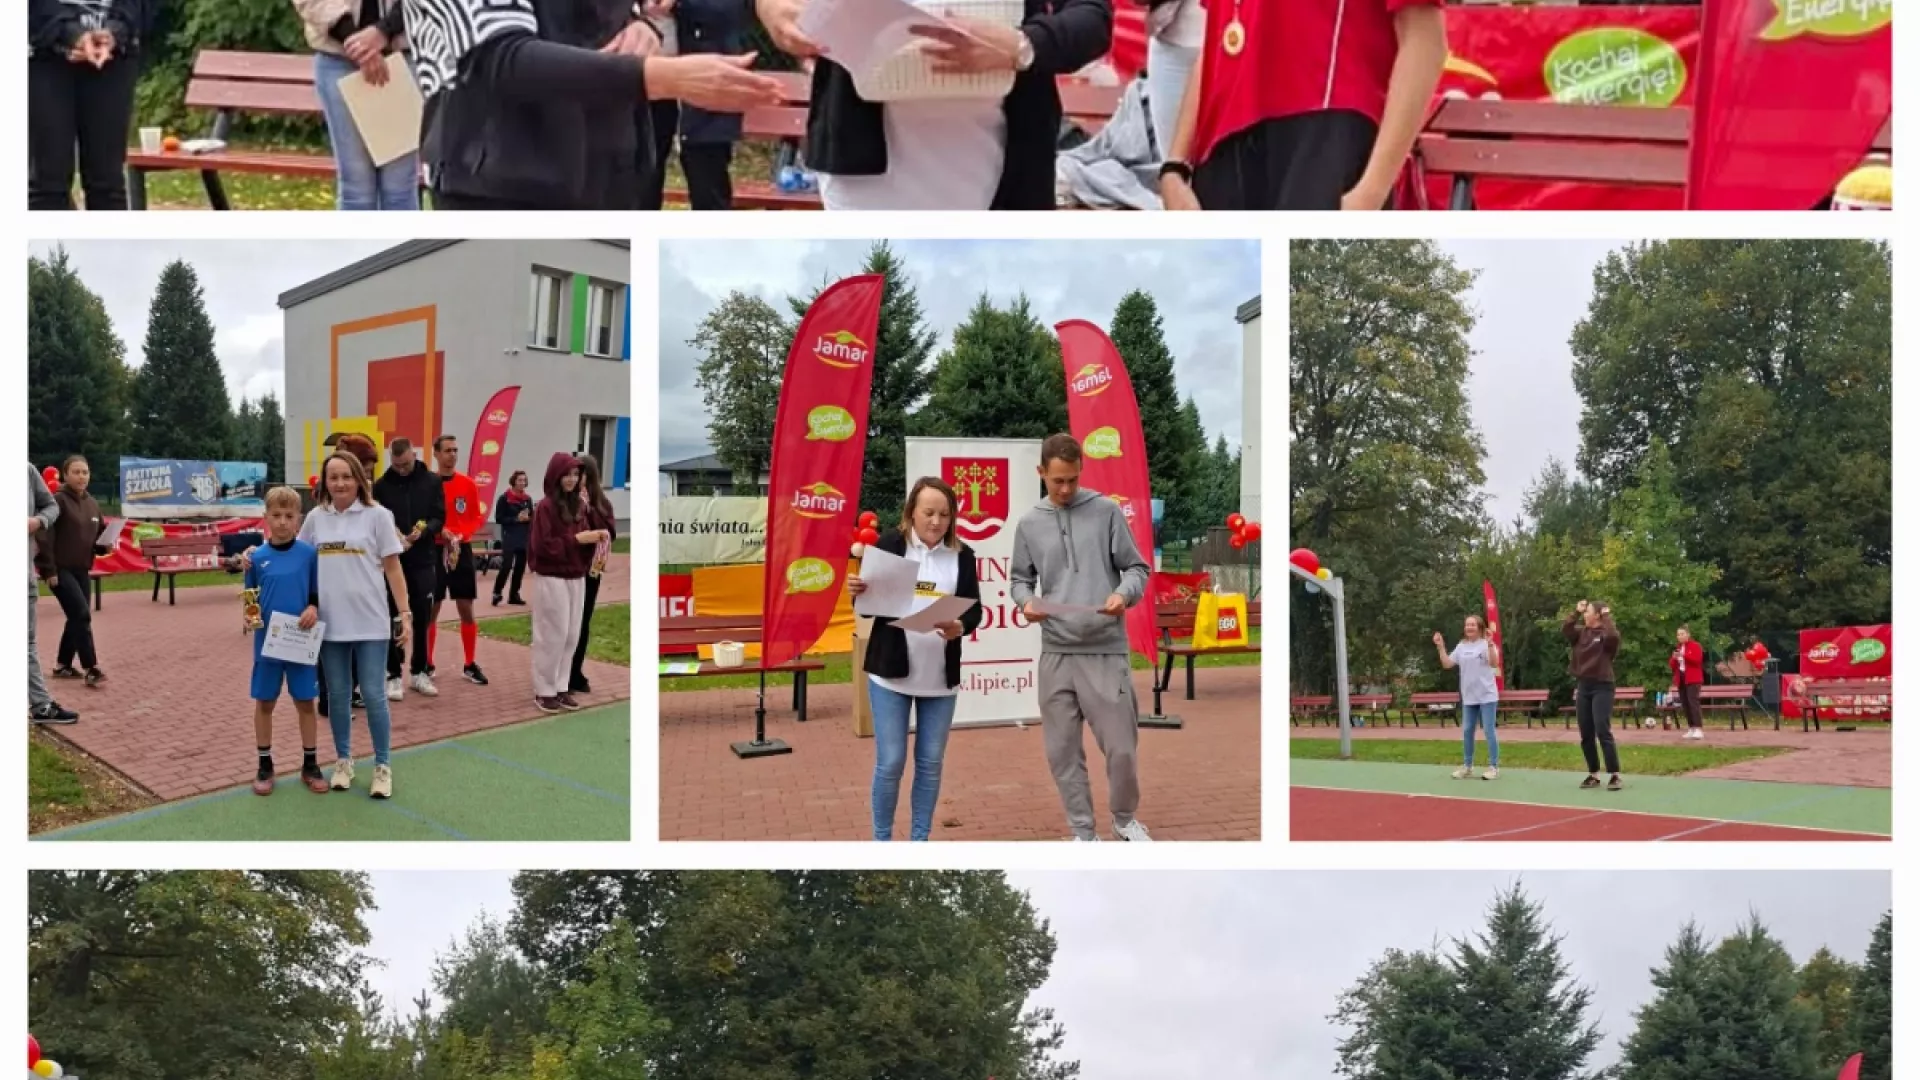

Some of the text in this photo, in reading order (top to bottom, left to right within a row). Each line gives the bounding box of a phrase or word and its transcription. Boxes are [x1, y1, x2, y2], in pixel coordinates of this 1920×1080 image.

[1553, 35, 1641, 88] Kochaj
[813, 336, 869, 363] Jamar
[791, 490, 846, 512] Jamar
[690, 518, 764, 534] świata...
